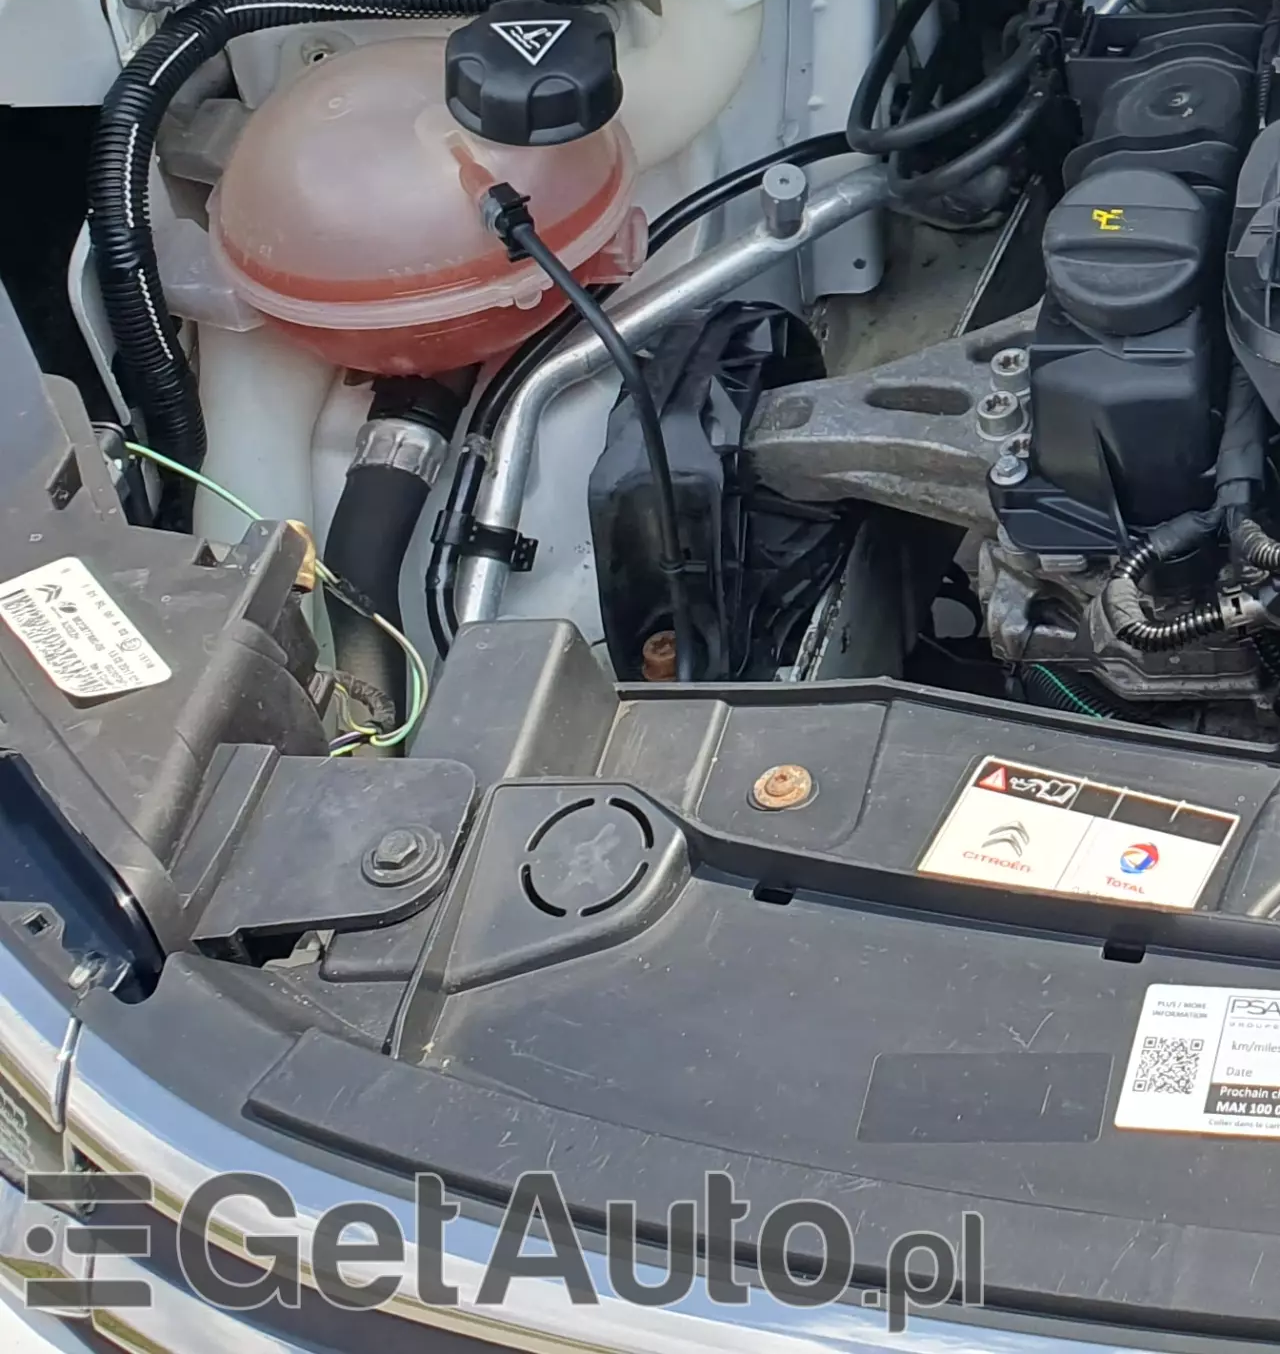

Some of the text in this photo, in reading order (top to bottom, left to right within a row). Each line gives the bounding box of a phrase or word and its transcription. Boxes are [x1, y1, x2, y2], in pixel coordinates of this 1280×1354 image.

[1105, 875, 1147, 895] TOTAL
[1157, 1000, 1177, 1009] PLUS
[1183, 1001, 1207, 1009] MORE
[1152, 1009, 1208, 1019] INFORMATION
[1226, 1066, 1253, 1078] Date
[1219, 1086, 1269, 1099] Prochain
[1216, 1101, 1247, 1114] MAX
[1249, 1103, 1272, 1115] 100
[1208, 1118, 1233, 1127] Coller
[1235, 1119, 1254, 1128] dans
